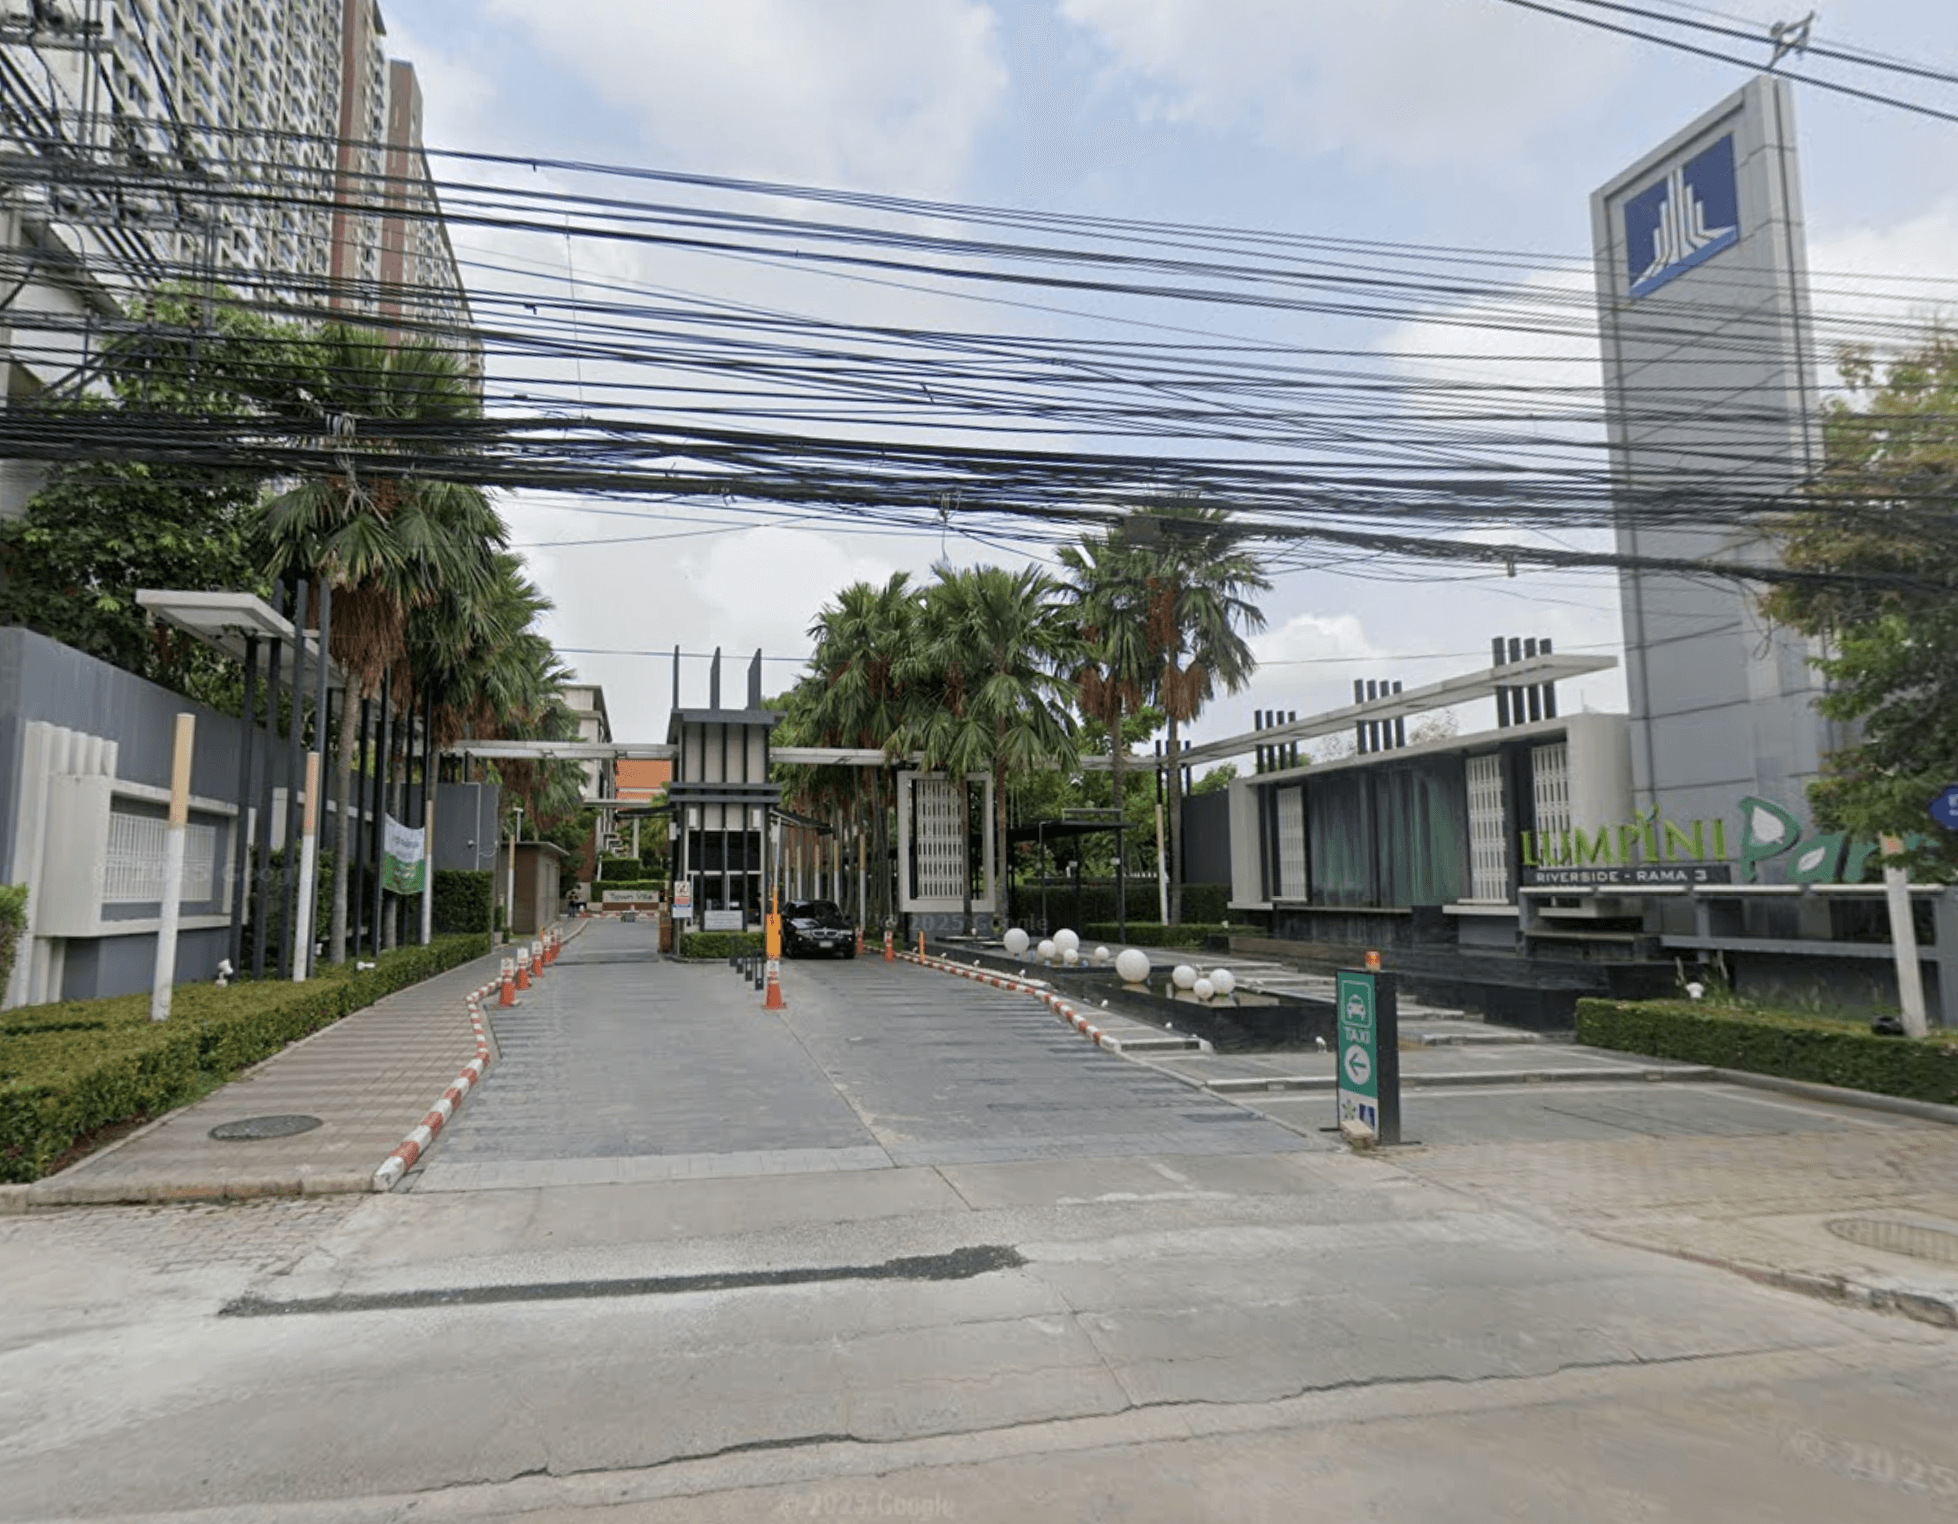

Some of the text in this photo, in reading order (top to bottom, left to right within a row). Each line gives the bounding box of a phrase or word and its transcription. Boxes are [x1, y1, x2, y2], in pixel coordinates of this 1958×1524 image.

[1536, 870, 1620, 883] RIVERSIDE
[1636, 869, 1688, 881] RAMA
[1694, 869, 1708, 881] 3
